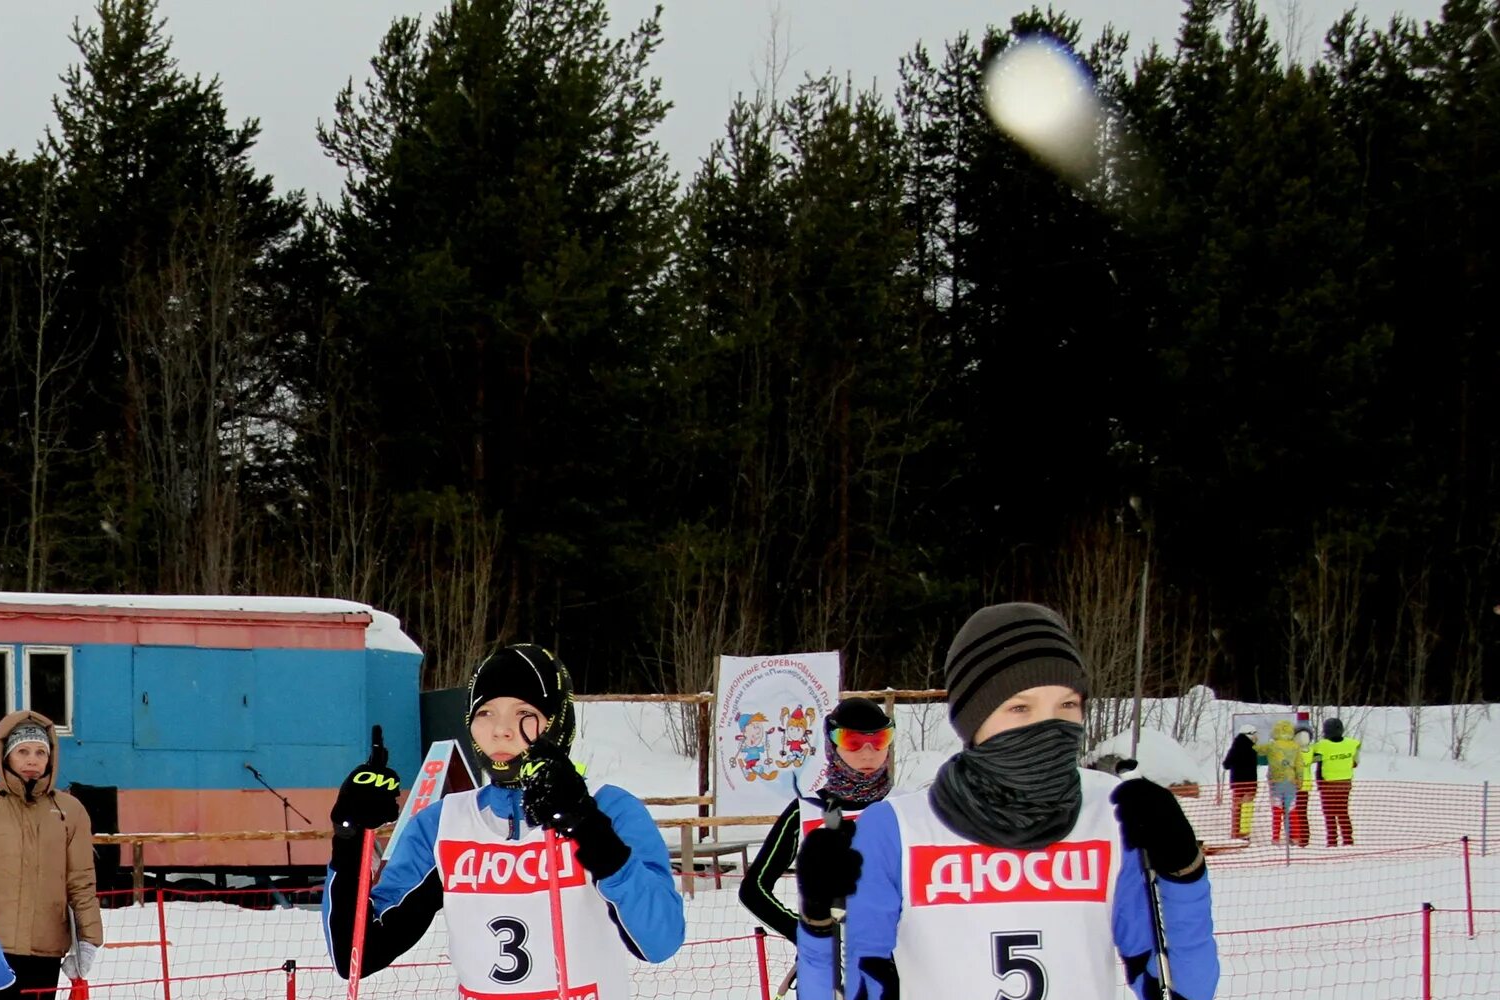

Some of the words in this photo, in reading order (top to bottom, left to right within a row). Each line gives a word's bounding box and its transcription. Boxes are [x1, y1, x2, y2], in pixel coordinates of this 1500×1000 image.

[761, 659, 823, 691] СОРЕВНОВАНИЯ
[448, 841, 574, 891] ДЮСШ
[925, 848, 1100, 903] ДЮСШ
[486, 915, 533, 985] 3
